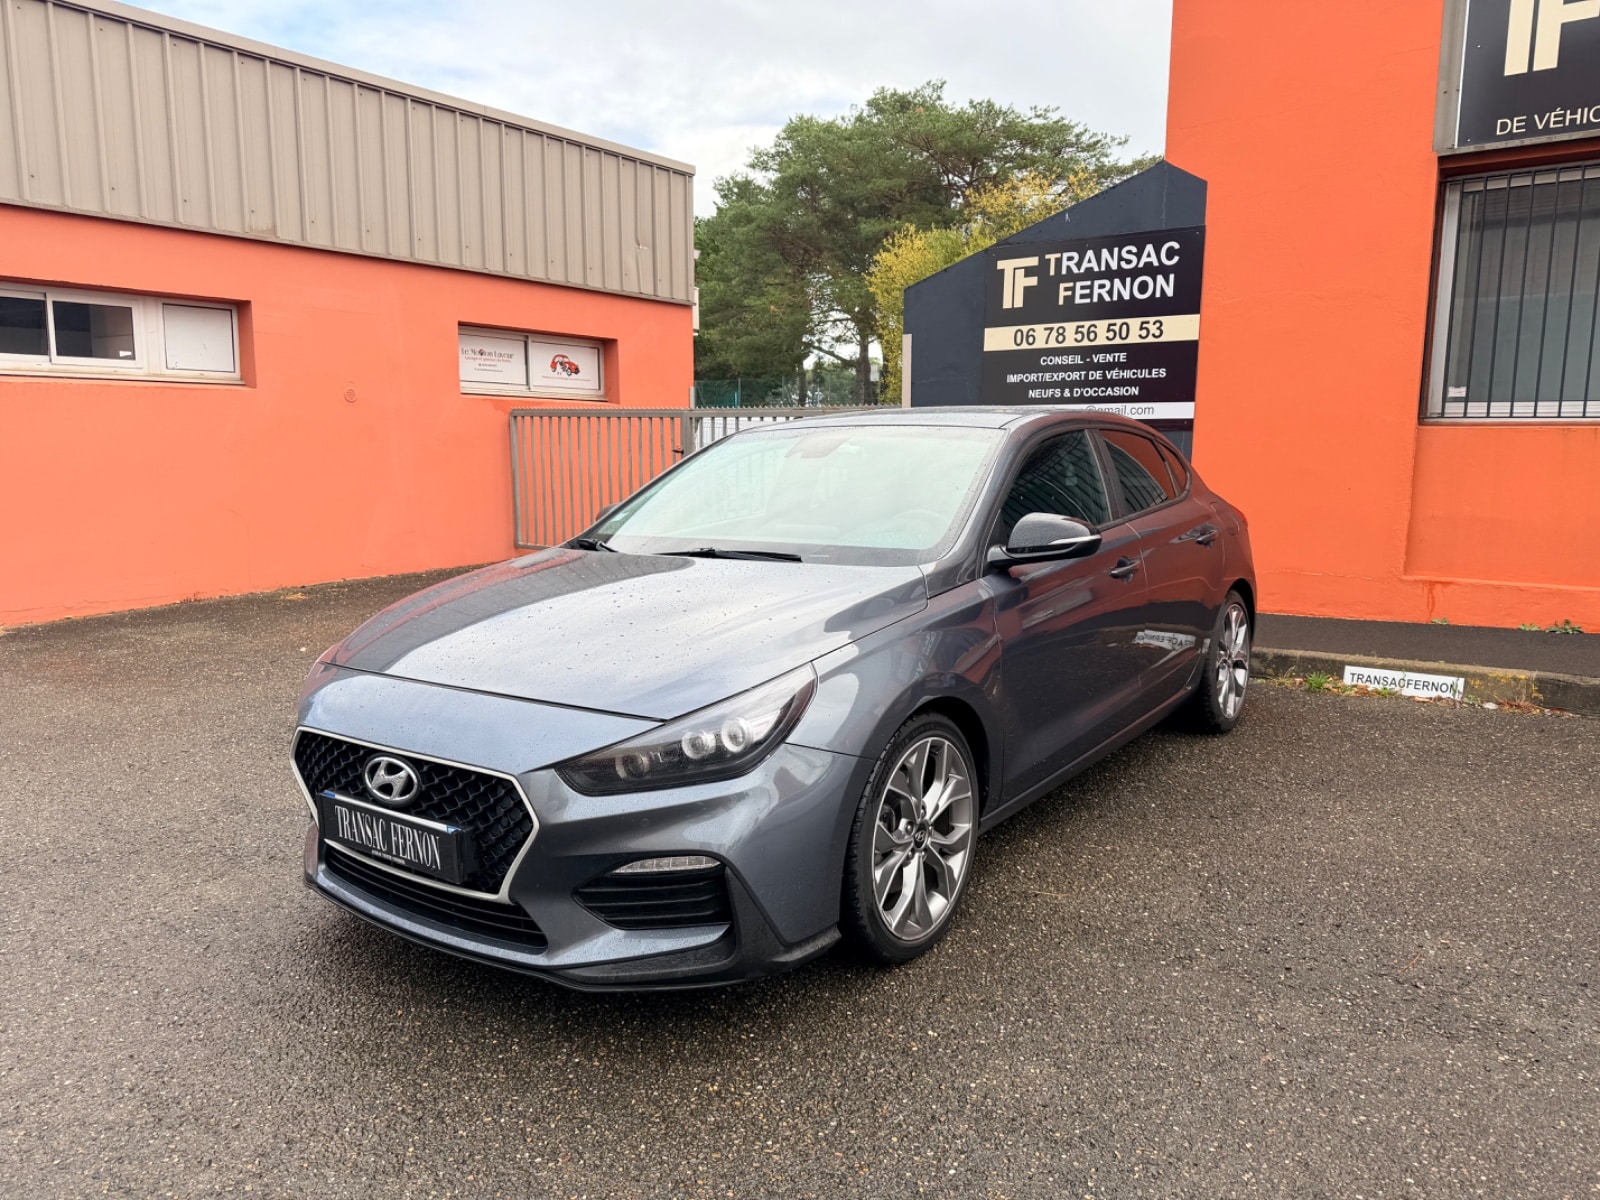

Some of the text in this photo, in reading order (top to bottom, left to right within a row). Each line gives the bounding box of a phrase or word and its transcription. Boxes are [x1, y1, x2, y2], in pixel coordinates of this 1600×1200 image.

[1496, 115, 1527, 136] DE
[1044, 241, 1181, 276] TRANSAC
[1058, 273, 1175, 306] FERNON
[1013, 319, 1164, 347] 06 78 56 50 53
[1040, 354, 1084, 366] CONSEIL
[1092, 352, 1127, 364] VENTE
[1006, 367, 1167, 383] IMPORT/EXPORT DE VÉHICULES
[1028, 386, 1139, 399] NEUFS & D'OCCASION
[334, 804, 441, 871] TRANSAC FERNON
